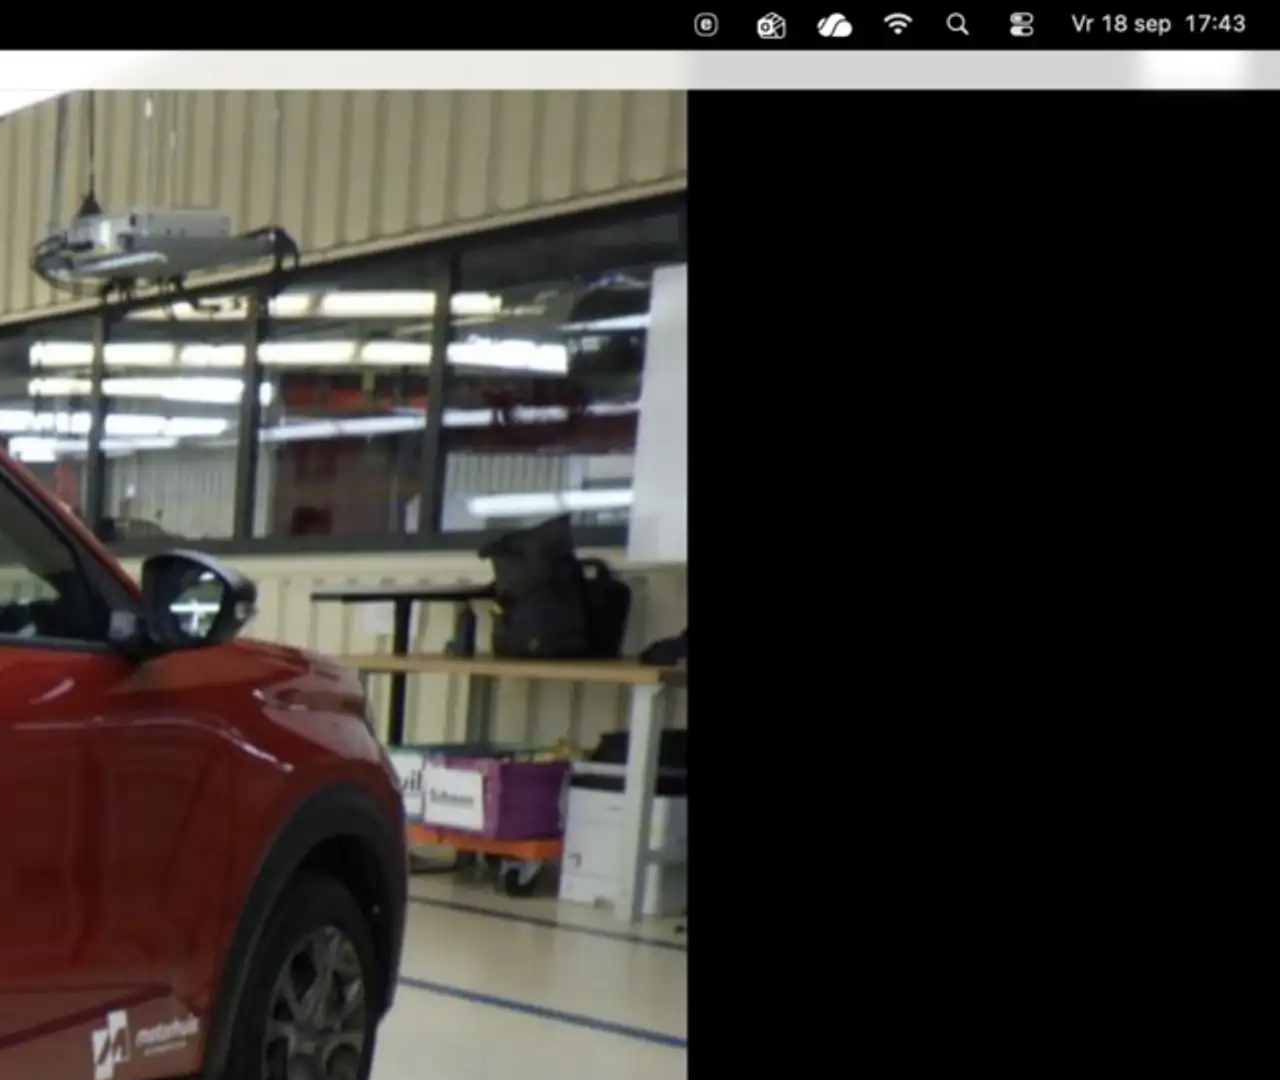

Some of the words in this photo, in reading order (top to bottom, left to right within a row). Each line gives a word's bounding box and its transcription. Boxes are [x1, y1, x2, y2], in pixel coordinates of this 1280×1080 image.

[1071, 14, 1093, 33] Vr
[1103, 14, 1127, 33] 18
[1135, 17, 1172, 37] sep
[1187, 14, 1246, 33] 17:43
